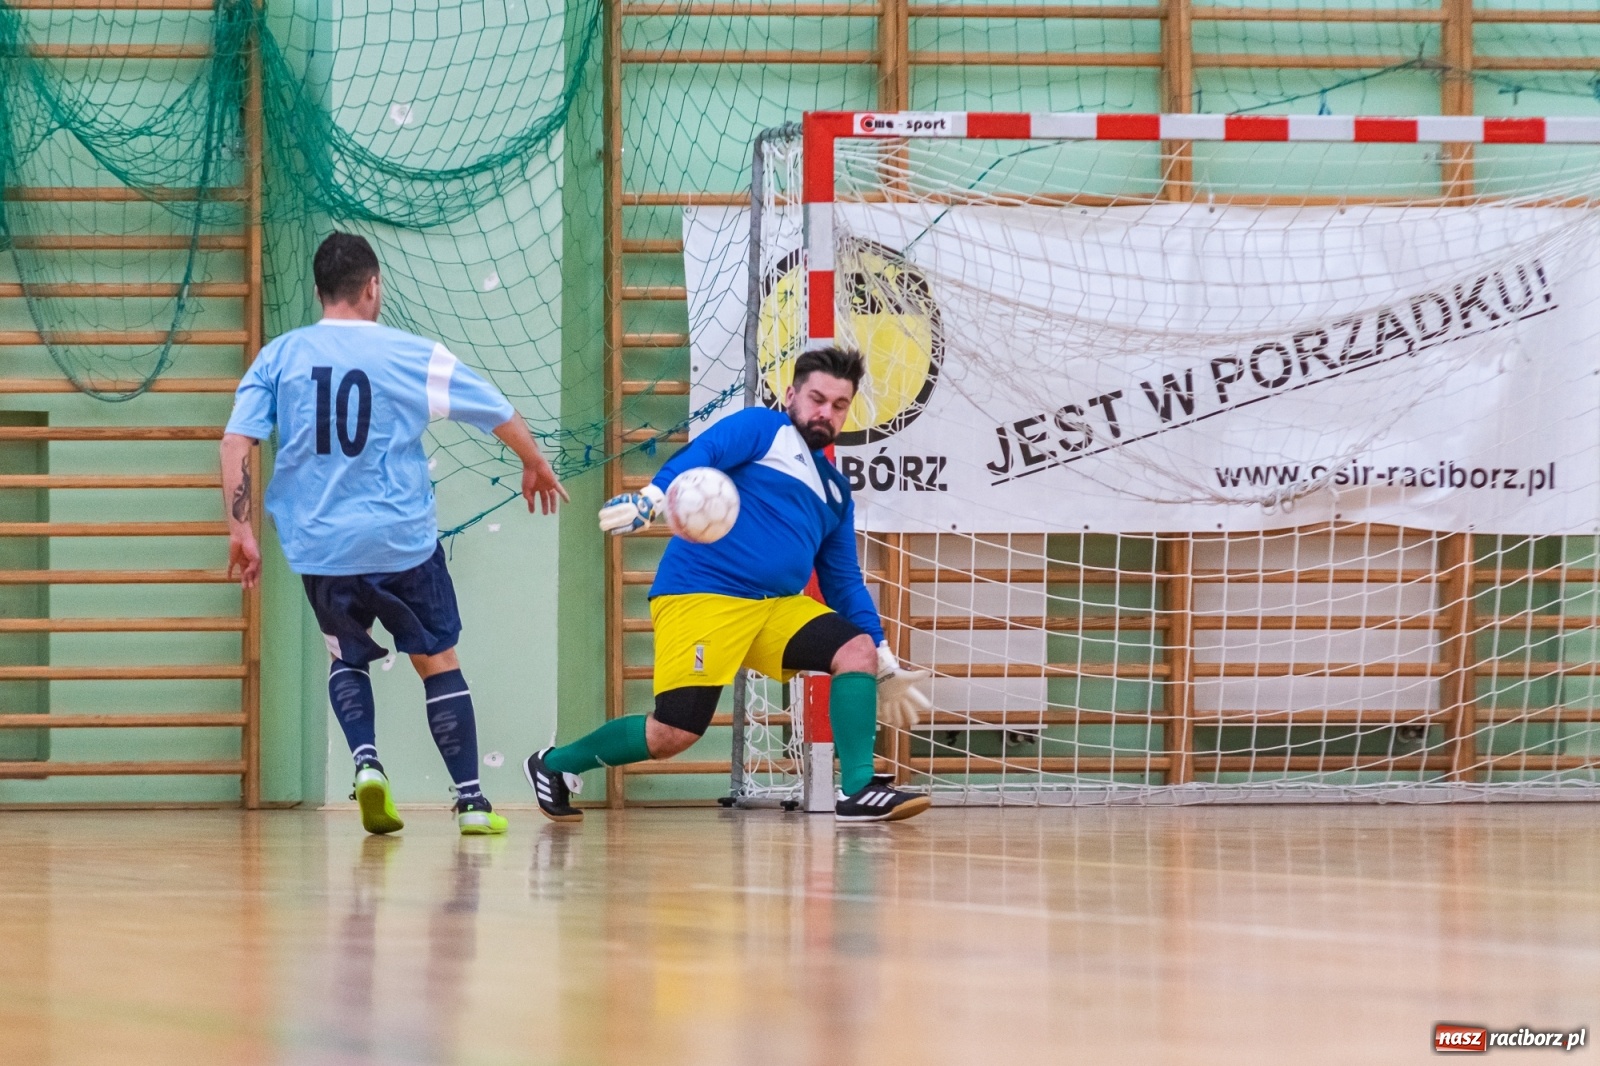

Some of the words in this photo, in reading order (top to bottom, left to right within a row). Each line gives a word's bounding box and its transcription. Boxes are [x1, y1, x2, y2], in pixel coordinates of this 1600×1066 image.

[906, 118, 946, 132] sport
[986, 389, 1123, 475] JEST
[1139, 368, 1194, 423] W
[1210, 259, 1552, 404] PORZĄDKU!
[311, 366, 372, 457] 10
[835, 446, 947, 492] BÓRZ
